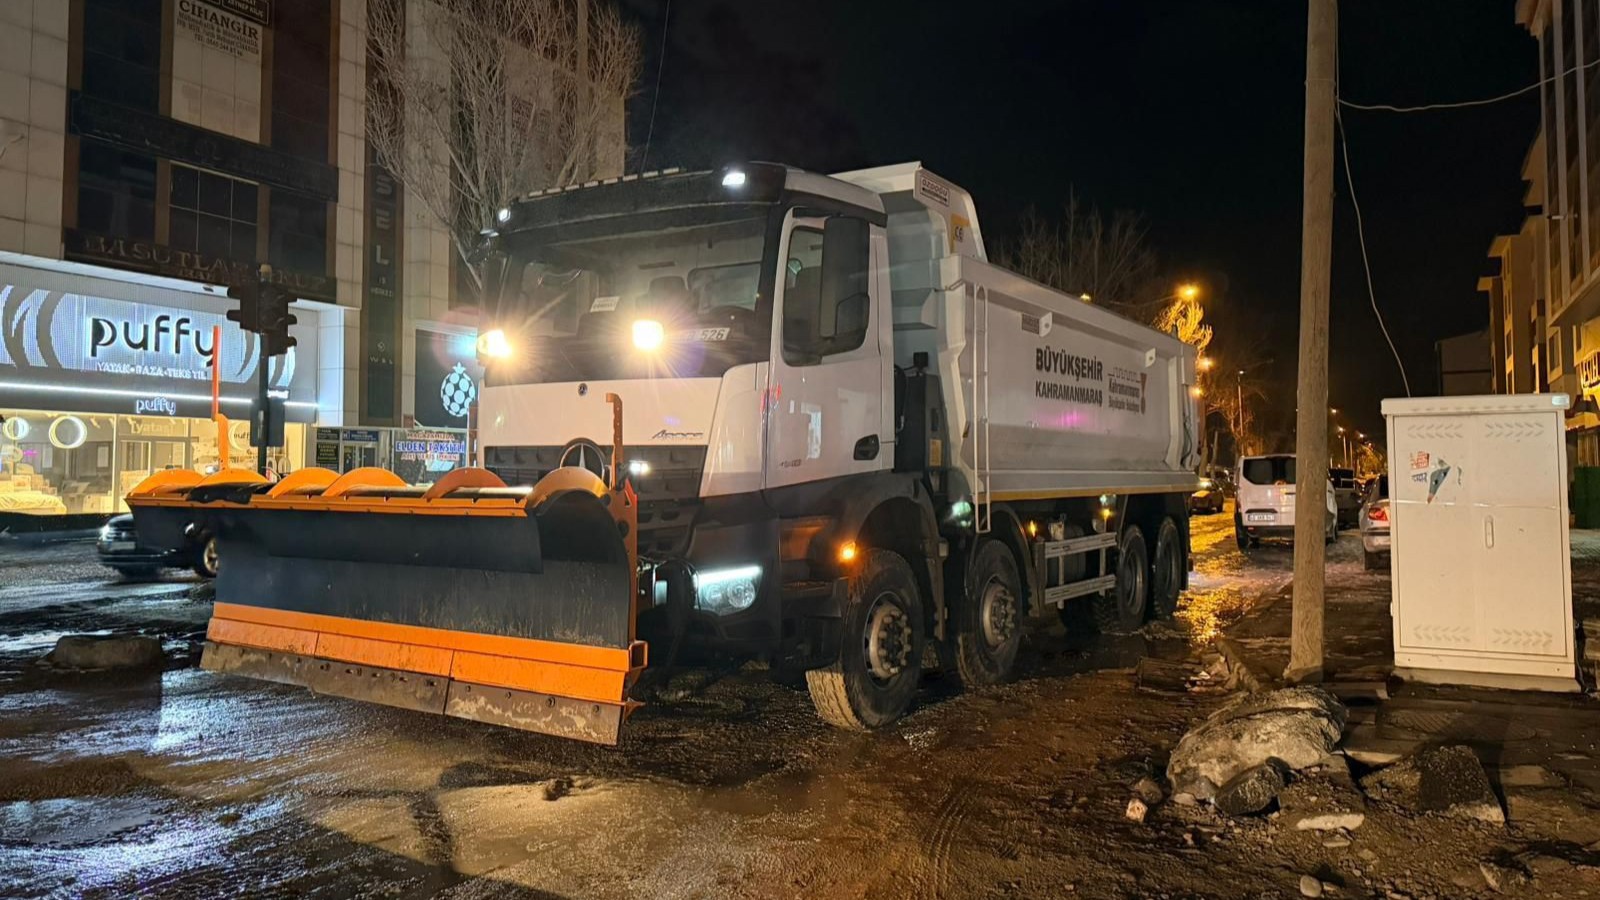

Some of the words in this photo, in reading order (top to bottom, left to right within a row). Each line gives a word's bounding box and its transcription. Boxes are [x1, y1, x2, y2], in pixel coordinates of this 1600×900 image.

[91, 315, 214, 368] puffy
[702, 328, 725, 340] 526
[1036, 345, 1103, 381] BÜYÜKŞEHİR
[135, 395, 177, 415] puffy
[1035, 380, 1103, 407] KAHRAMANMARAŞ
[395, 441, 426, 452] ELDEN
